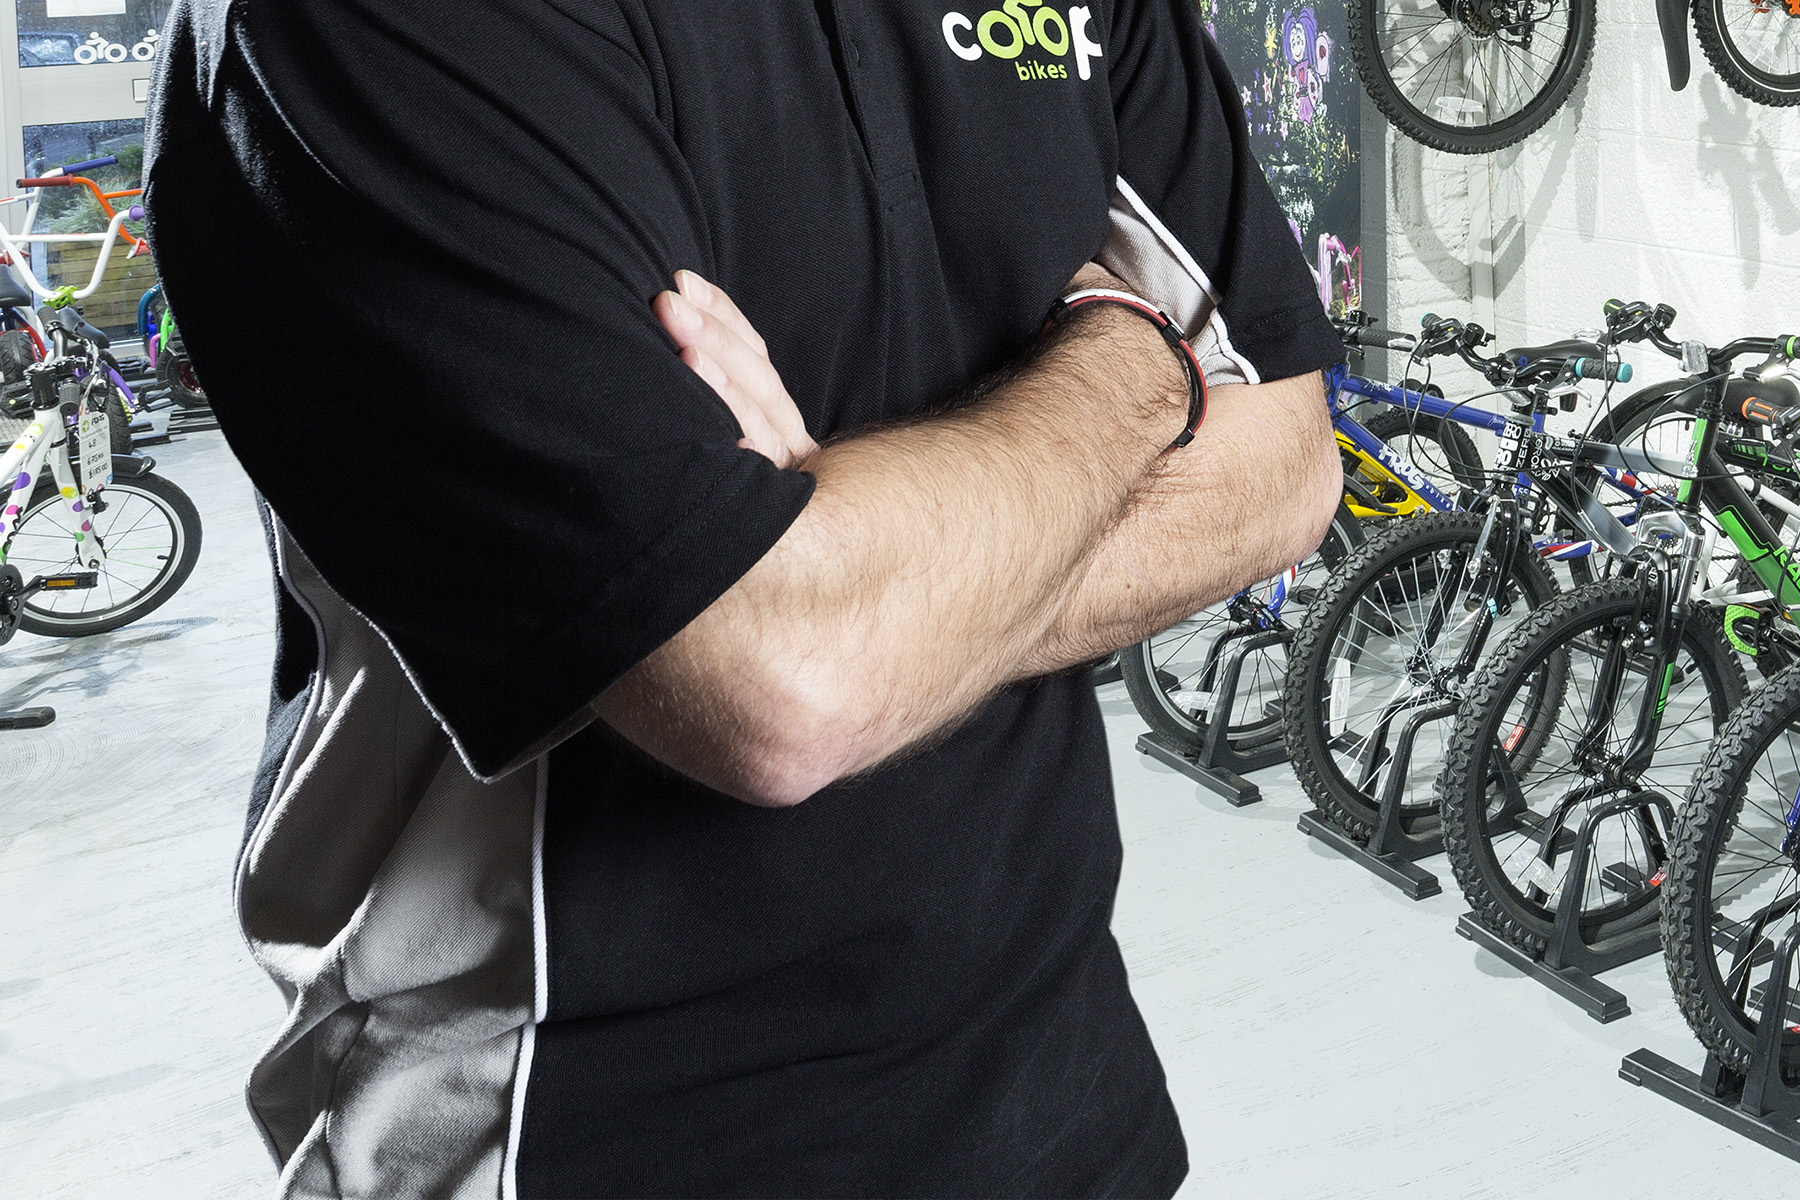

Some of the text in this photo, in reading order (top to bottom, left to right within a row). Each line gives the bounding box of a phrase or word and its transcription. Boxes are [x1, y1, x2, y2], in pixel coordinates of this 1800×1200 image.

[942, 6, 1103, 81] coop
[1015, 60, 1068, 81] bikes
[1378, 443, 1426, 491] FROG
